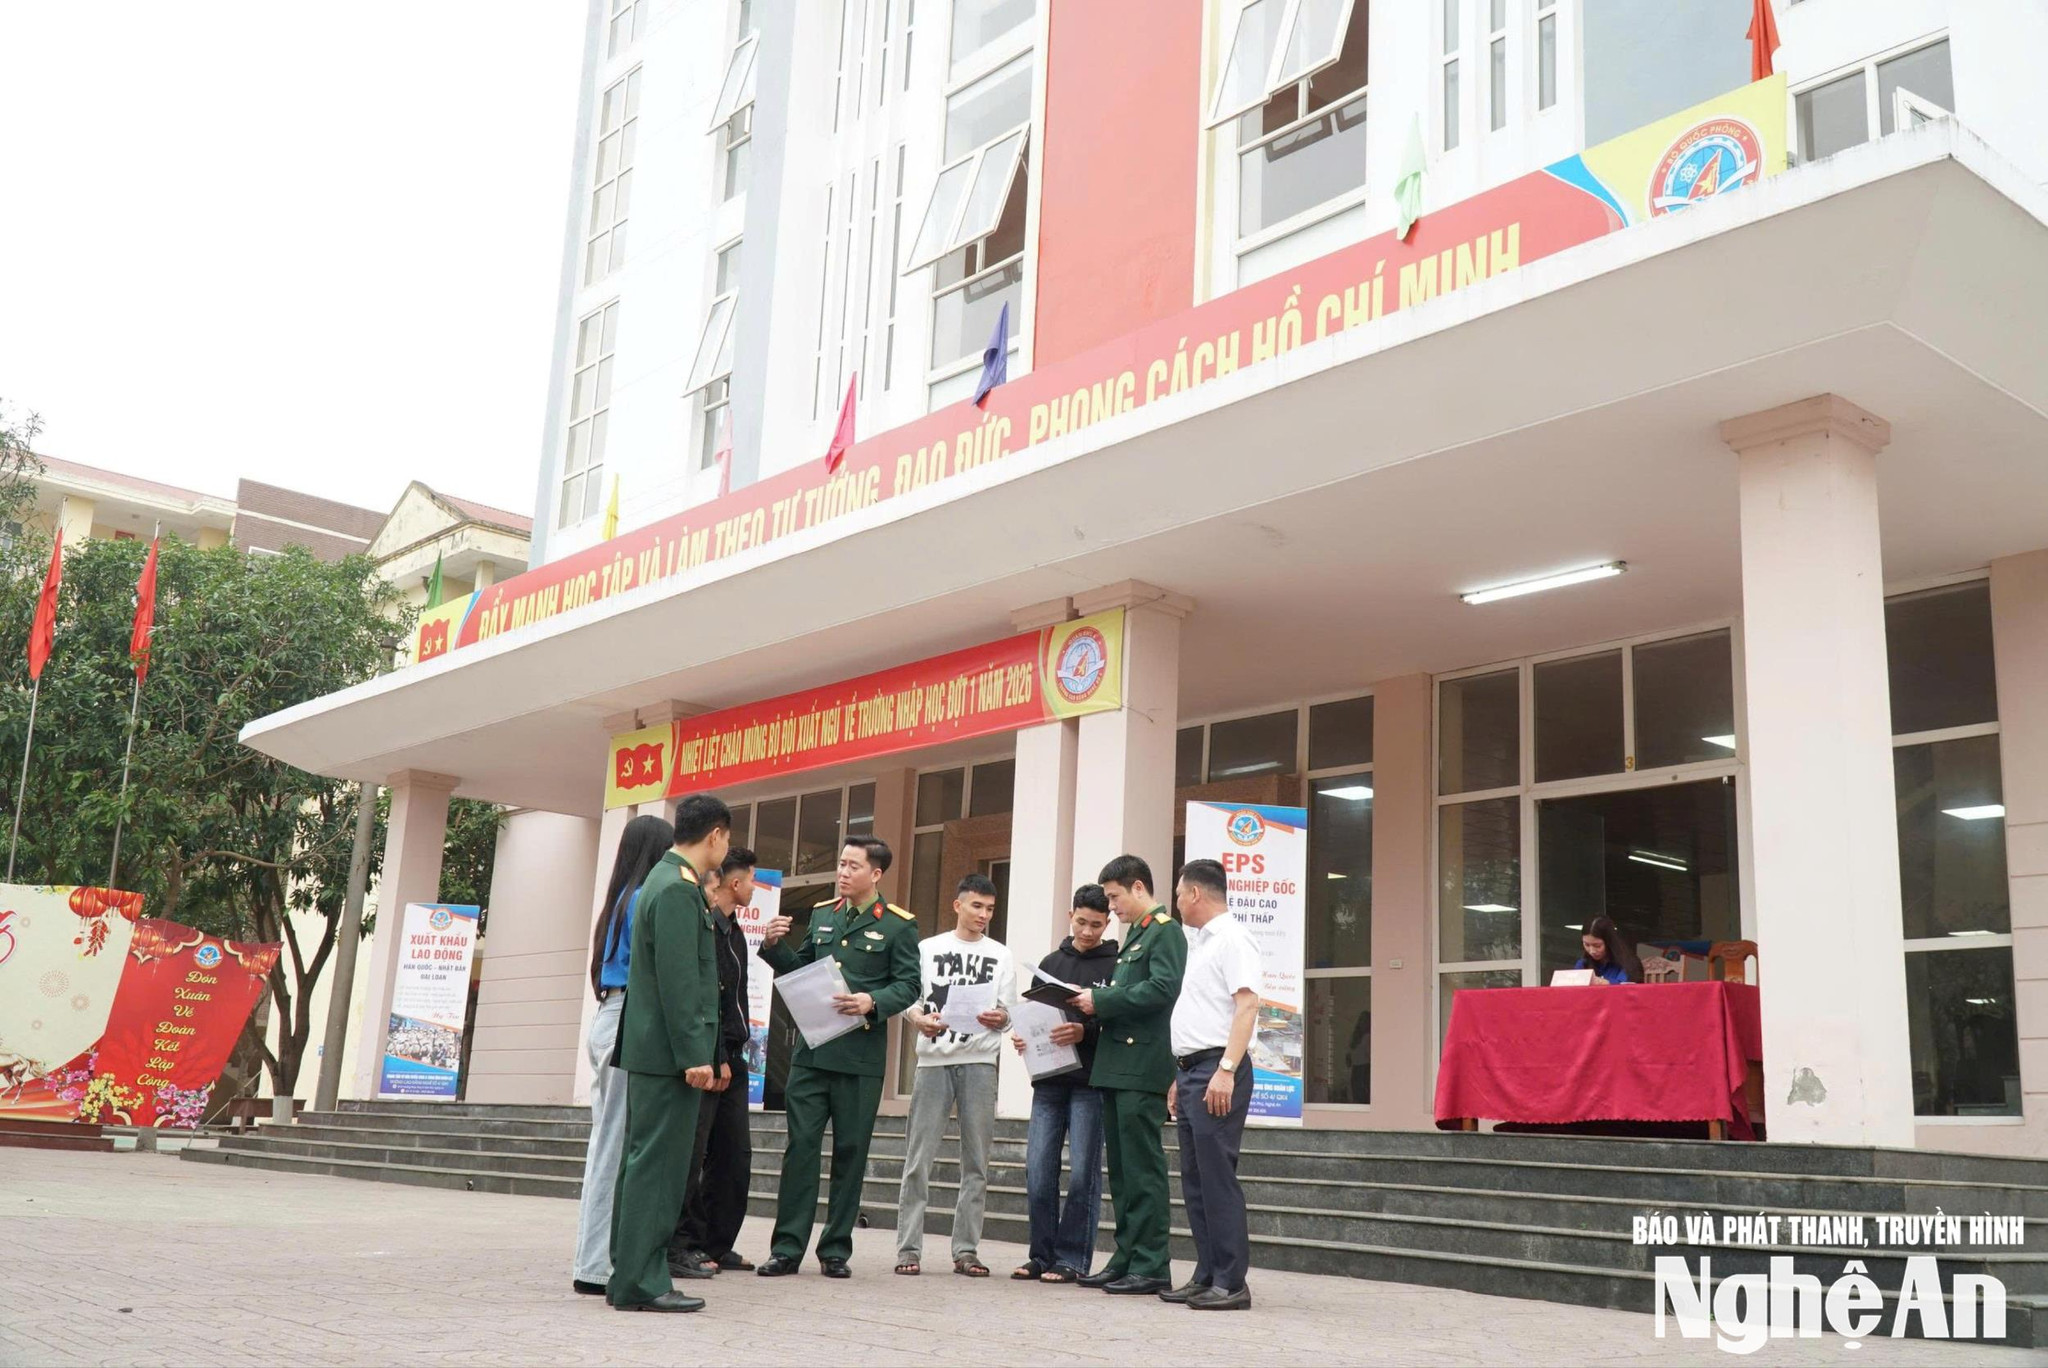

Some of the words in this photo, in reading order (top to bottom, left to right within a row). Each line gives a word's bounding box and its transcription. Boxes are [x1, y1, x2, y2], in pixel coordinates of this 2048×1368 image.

[1028, 370, 1136, 448] PHONG
[1145, 330, 1240, 403] CÁCH
[1251, 284, 1303, 367] HỒ
[1315, 259, 1387, 344] CHÍ
[1399, 222, 1521, 312] MINH
[703, 728, 721, 778] LIỆT
[720, 723, 742, 768] CHÀO
[767, 713, 781, 766] BỘ
[780, 709, 797, 763] ĐỘI
[796, 698, 821, 752] XUẤT
[857, 687, 895, 739] TRƯỜNG
[895, 680, 924, 738] NHẬP
[924, 682, 946, 733] HỌC
[946, 673, 969, 728] ĐỢT
[969, 676, 977, 716] 1
[977, 661, 1005, 713] NĂM
[1004, 661, 1033, 708] 2026
[1221, 852, 1265, 875] EPS
[1228, 877, 1270, 896] NGHIỆP
[1273, 877, 1296, 895] GỐC
[1259, 899, 1278, 909] CAO
[1249, 911, 1275, 924] THẤP
[740, 922, 767, 937] NGHIỆ
[410, 931, 437, 946] XUẤT
[411, 949, 431, 960] LAO
[434, 947, 463, 963] ĐỘNG
[933, 951, 999, 981] TAKE
[185, 970, 219, 985] Đón
[156, 1021, 196, 1037] Đoàn
